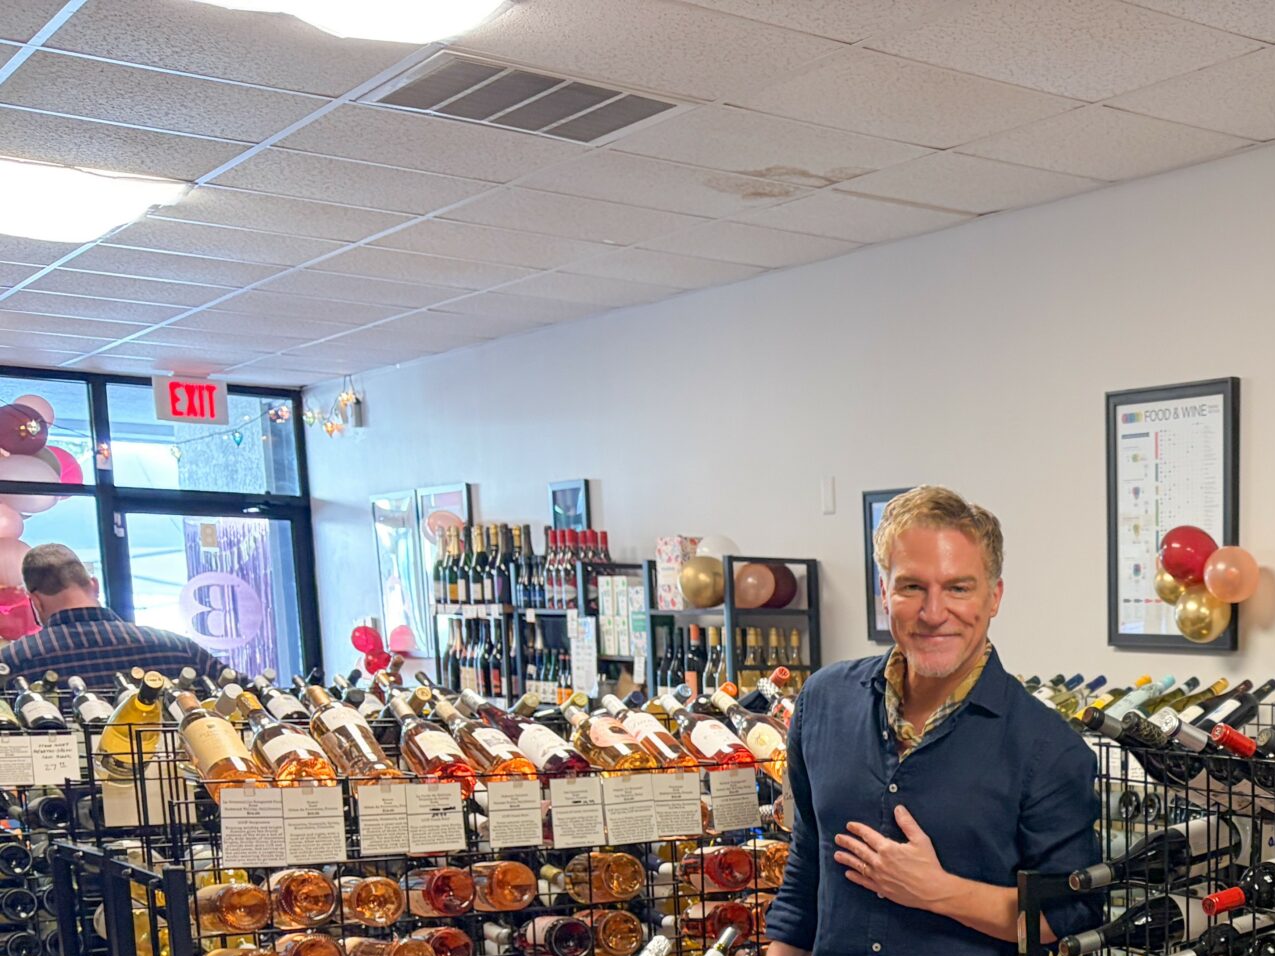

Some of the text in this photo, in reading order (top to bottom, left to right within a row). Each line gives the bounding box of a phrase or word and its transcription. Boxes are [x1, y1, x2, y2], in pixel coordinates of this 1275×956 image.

[169, 381, 217, 419] EXIT
[1144, 407, 1171, 422] FOOD
[1172, 407, 1181, 420] &
[1181, 403, 1207, 418] WINE
